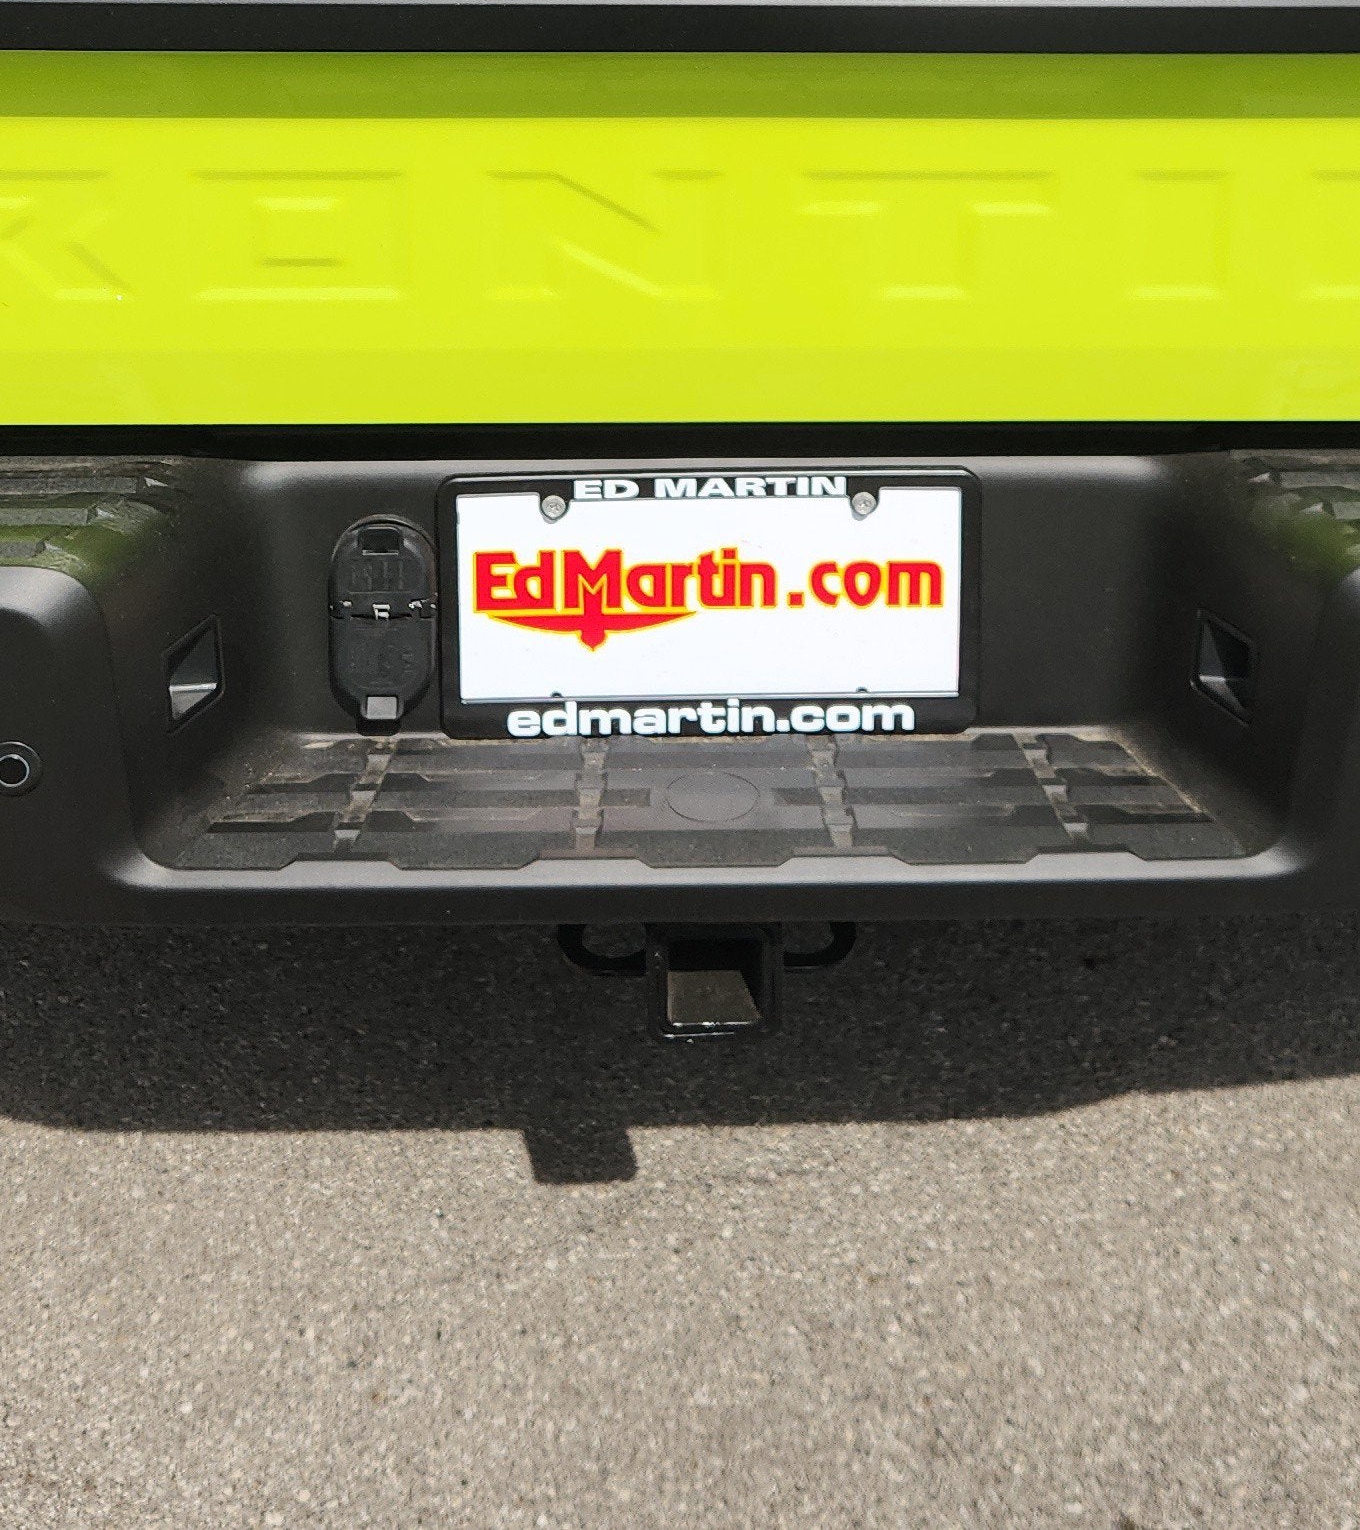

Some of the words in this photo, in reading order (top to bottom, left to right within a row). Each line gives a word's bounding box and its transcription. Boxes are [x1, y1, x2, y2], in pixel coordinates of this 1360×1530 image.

[573, 477, 639, 501] ED
[653, 476, 847, 499] MARTIN
[506, 697, 915, 739] edmartin.com
